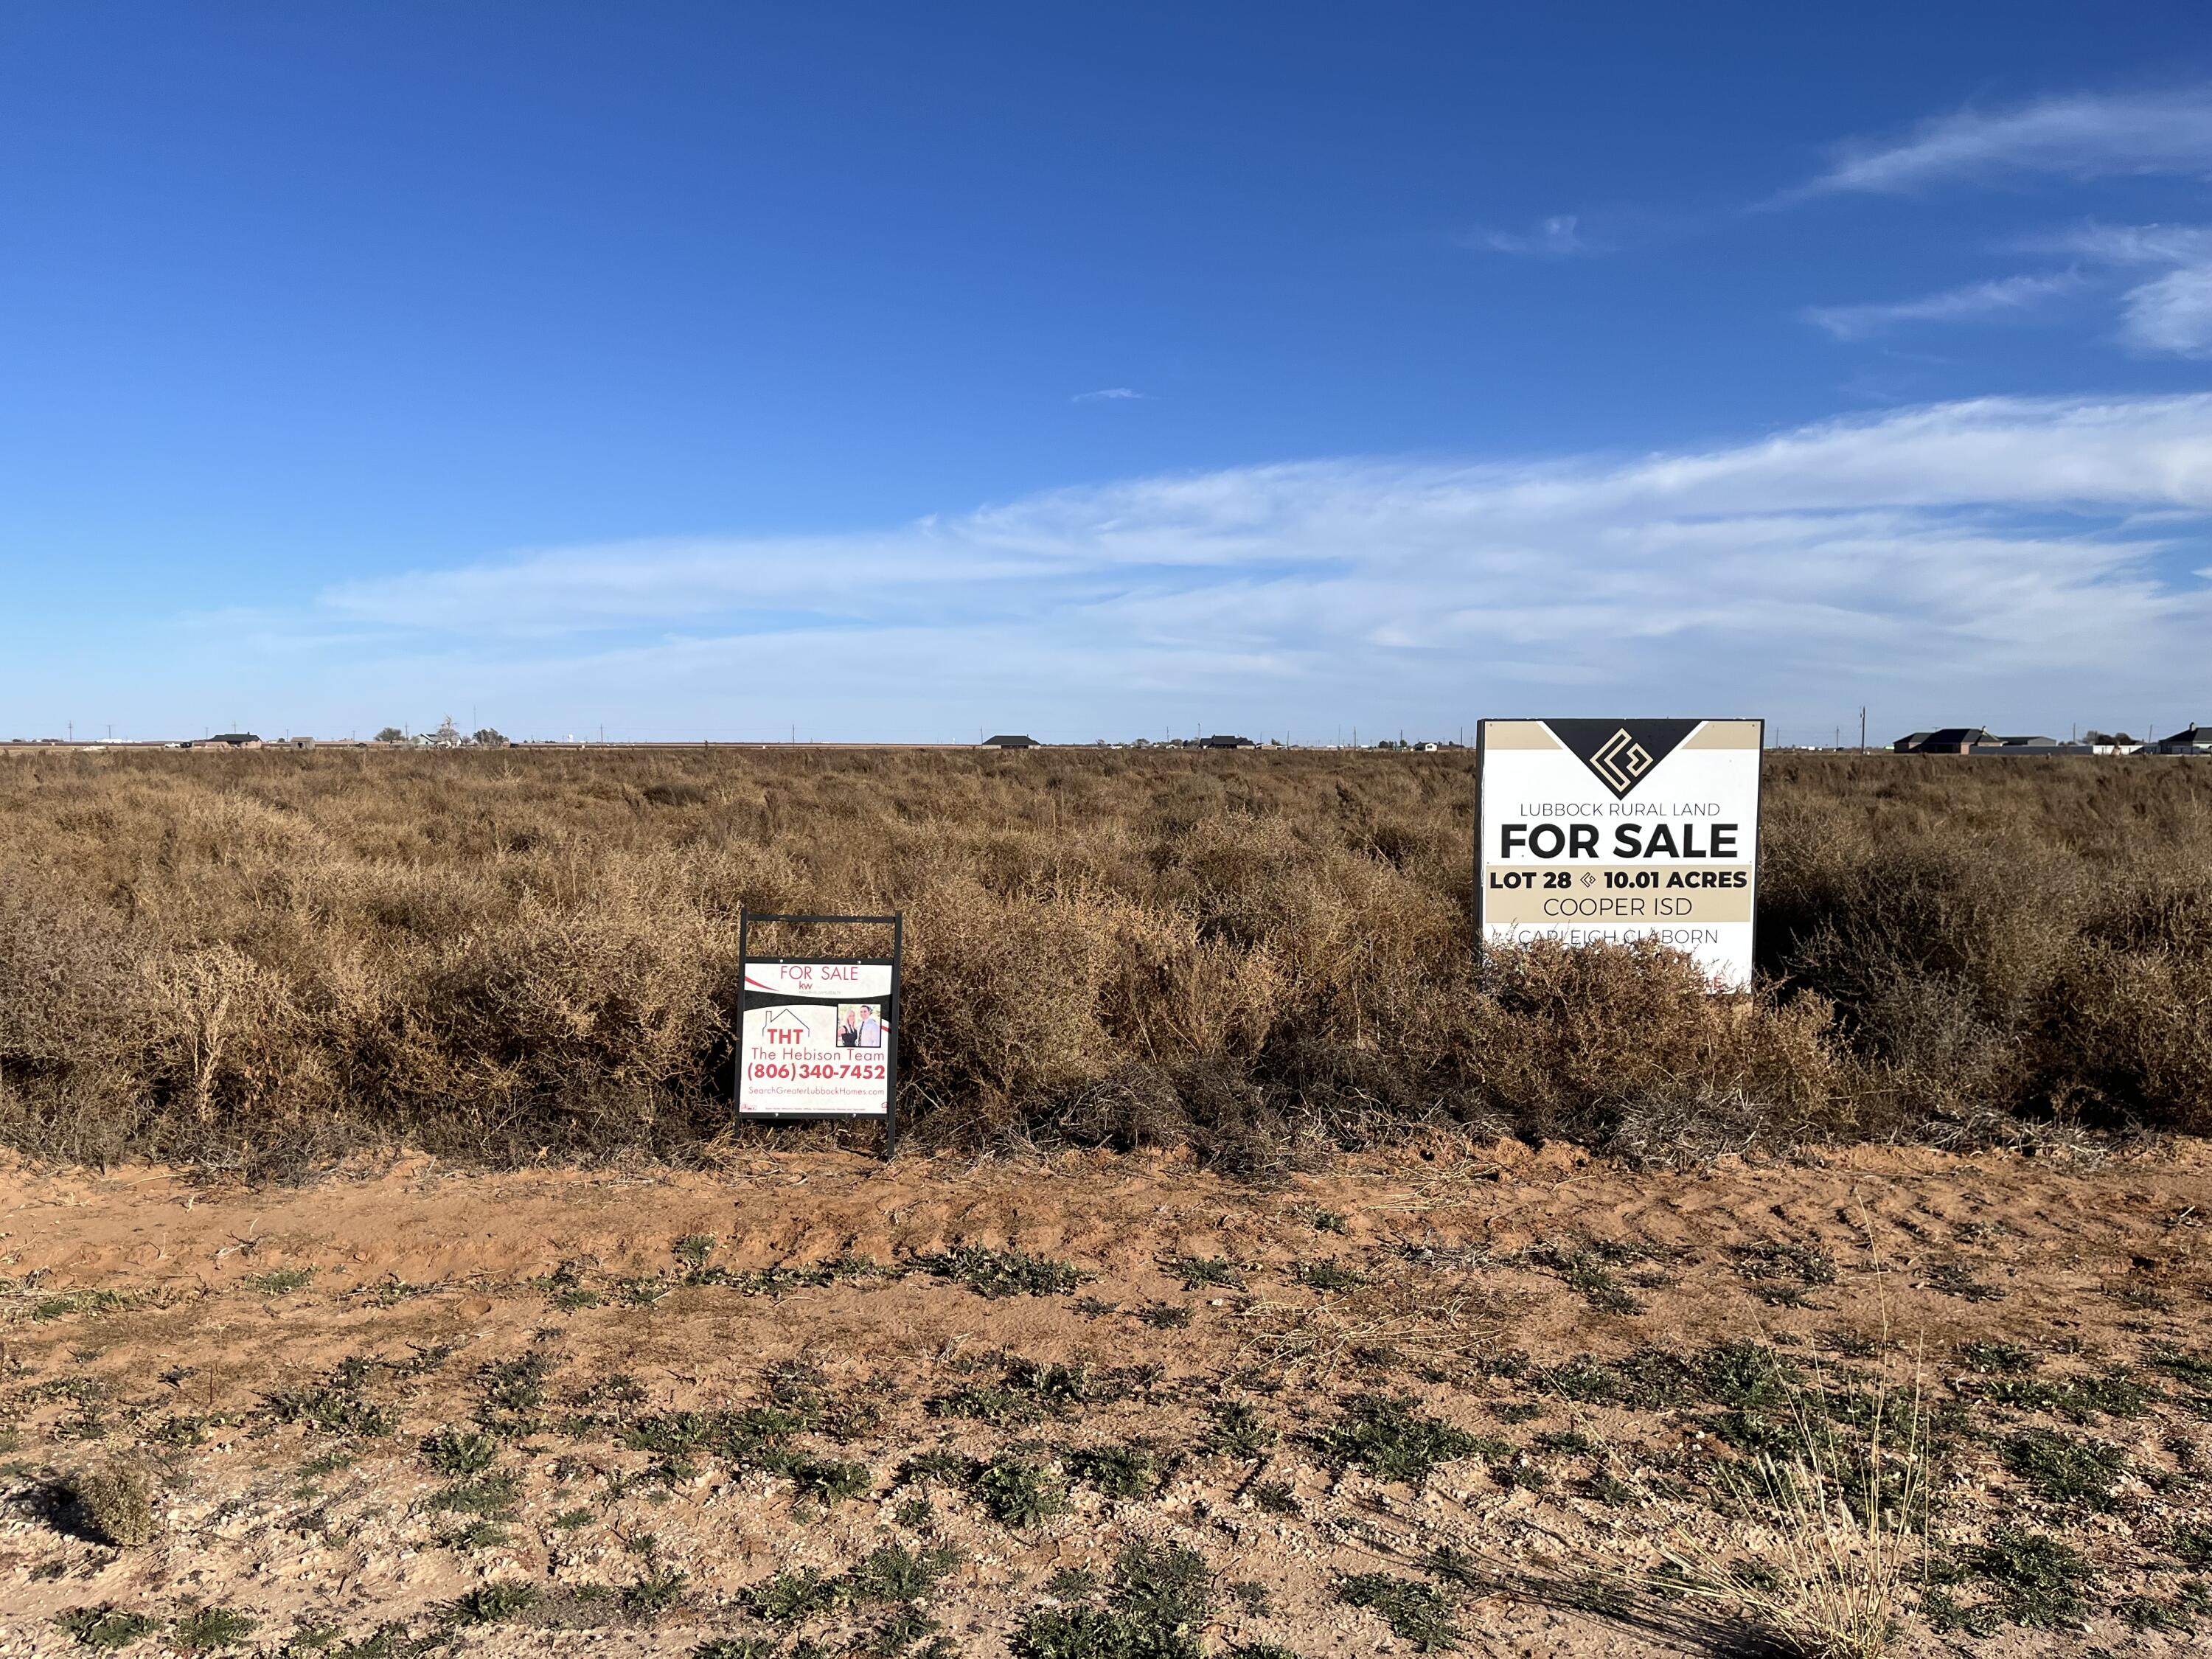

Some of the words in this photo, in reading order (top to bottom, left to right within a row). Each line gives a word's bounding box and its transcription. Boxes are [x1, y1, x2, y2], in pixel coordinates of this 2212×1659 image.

[1520, 803, 1603, 816] LUBBOCK
[1610, 803, 1666, 816] RURAL
[1673, 803, 1720, 816] LAND
[1501, 824, 1599, 858] FOR
[1613, 824, 1738, 858] SALE
[1490, 872, 1537, 888] LOT
[1543, 872, 1571, 888] 28
[1604, 872, 1659, 888] 10.01
[1666, 871, 1747, 888] ACRES
[1544, 898, 1645, 916] COOPER
[1655, 898, 1692, 915] ISD
[1518, 930, 1616, 945] CARLEIGH
[781, 966, 813, 980] FOR
[821, 966, 858, 980] SALE
[799, 981, 813, 990] kw
[768, 1029, 803, 1044] THT
[752, 1048, 776, 1060] The
[783, 1048, 840, 1060] Hebison
[847, 1048, 884, 1060] Team
[748, 1063, 885, 1081] (806)340-7452
[748, 1087, 884, 1095] SearchGreaterLubbockHomes.com
